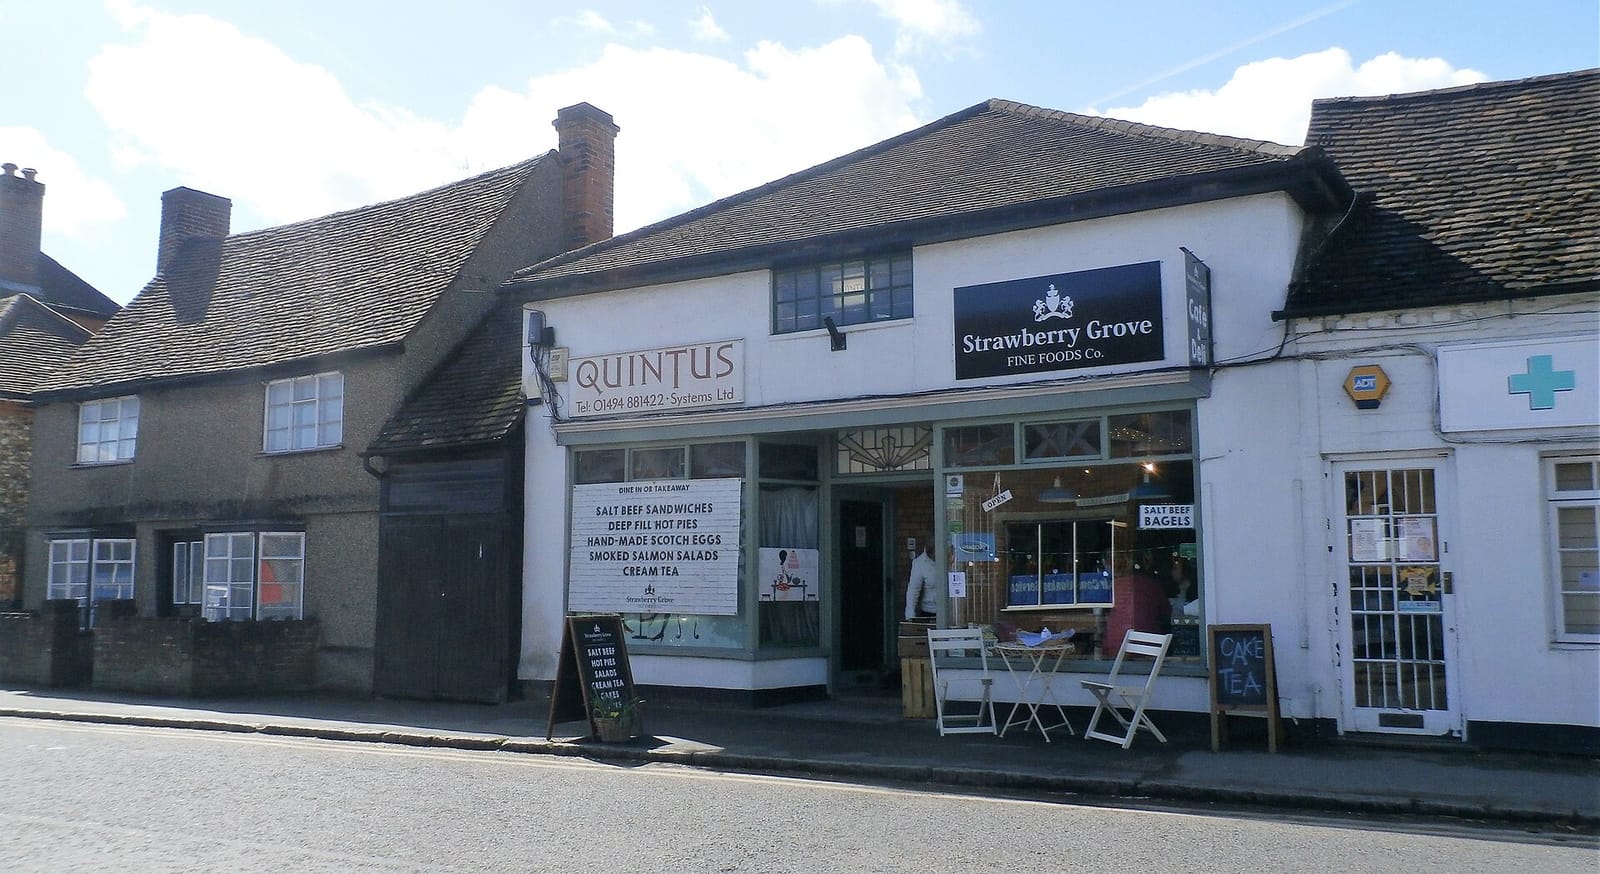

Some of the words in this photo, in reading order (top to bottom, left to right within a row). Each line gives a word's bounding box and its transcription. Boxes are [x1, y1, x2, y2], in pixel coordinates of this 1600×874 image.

[963, 327, 1080, 354] Strawberry
[1086, 319, 1153, 339] Grove
[1191, 338, 1206, 366] Deli
[1007, 354, 1035, 367] FINE
[1039, 350, 1081, 364] FOODS
[1084, 349, 1104, 359] Co.
[576, 343, 734, 395] QUINTUS
[1354, 378, 1376, 389] ADT
[576, 401, 591, 413] Tel:
[593, 398, 624, 412] 01494
[627, 393, 664, 409] 881422
[671, 393, 712, 406] Systems
[717, 387, 734, 400] Ltd
[619, 486, 634, 494] DINE
[654, 484, 690, 492] TAKEAWAY
[987, 494, 1007, 508] OPEN
[596, 505, 619, 516] SALT
[621, 505, 643, 515] BEEF
[646, 503, 713, 515] SANDWICHES
[1144, 506, 1167, 514] SALT
[1169, 506, 1190, 514] BEEF
[608, 521, 632, 531] DEEP
[635, 520, 652, 530] FILL
[655, 520, 674, 530] HOT
[677, 519, 698, 529] PIES
[1144, 516, 1190, 526] BAGELS
[587, 536, 648, 546] HAND-MADE
[651, 535, 689, 545] SCOTCH
[692, 535, 721, 545] EGGS
[589, 551, 629, 561] SMOKED
[632, 551, 674, 561] SALMON
[677, 550, 719, 561] SALADS
[623, 566, 658, 576] CREAM
[661, 566, 679, 576] TEA
[587, 648, 601, 657] SALT
[602, 647, 615, 656] BEEF
[1221, 636, 1264, 665] CAKE
[591, 658, 603, 667] HOT
[604, 658, 616, 666] PIES
[594, 669, 617, 678] SALADS
[591, 680, 612, 690] CREAM
[613, 679, 624, 687] TEA
[1218, 668, 1262, 696] TEA
